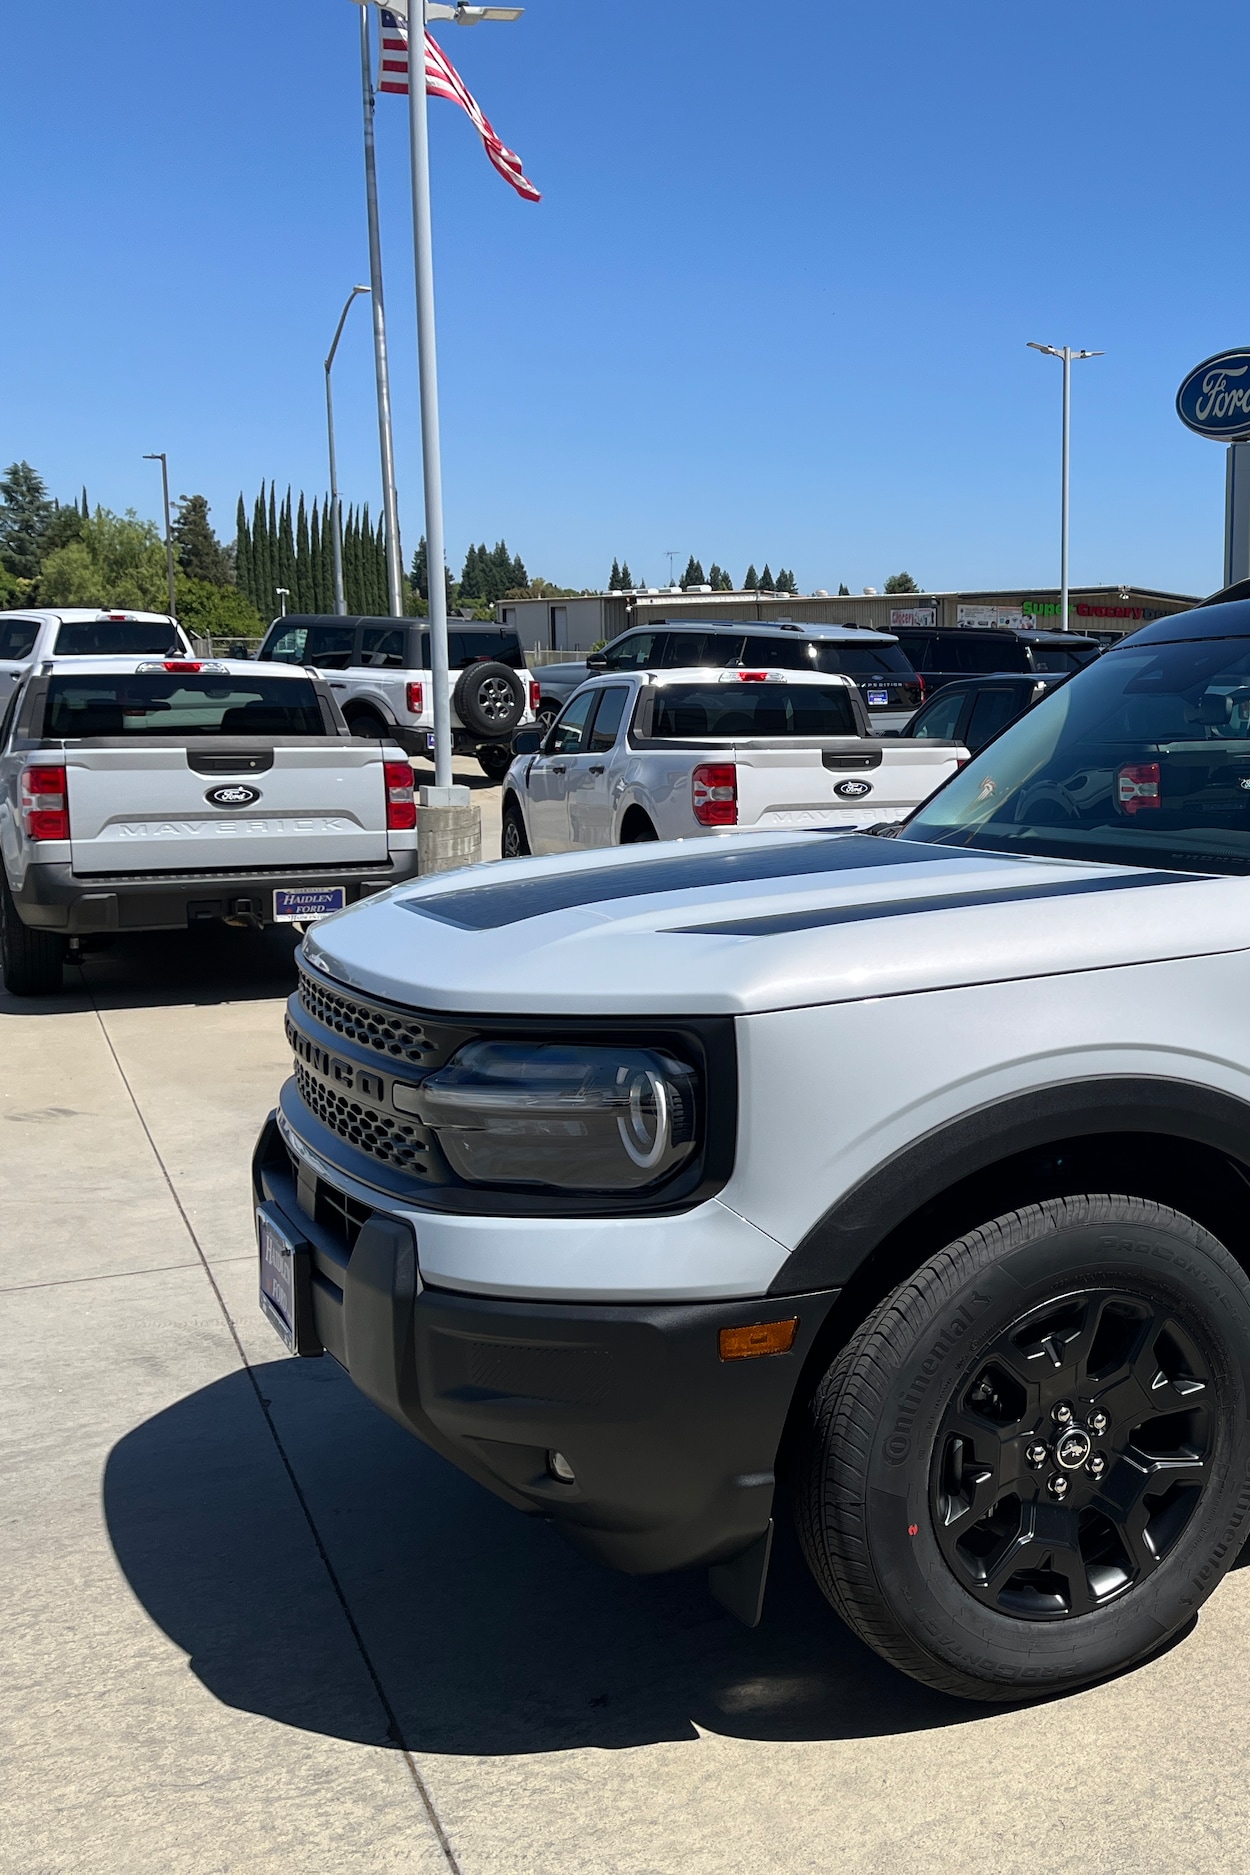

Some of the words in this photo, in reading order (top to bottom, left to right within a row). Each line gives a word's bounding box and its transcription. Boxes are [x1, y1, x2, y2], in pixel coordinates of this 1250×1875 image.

[1077, 603, 1143, 620] Grocery
[844, 782, 866, 795] Ford
[220, 789, 247, 802] Ford
[771, 808, 910, 824] MAVERIC
[119, 818, 344, 837] MAVERICK
[282, 894, 334, 906] HAIDLEN
[296, 905, 326, 914] FORD
